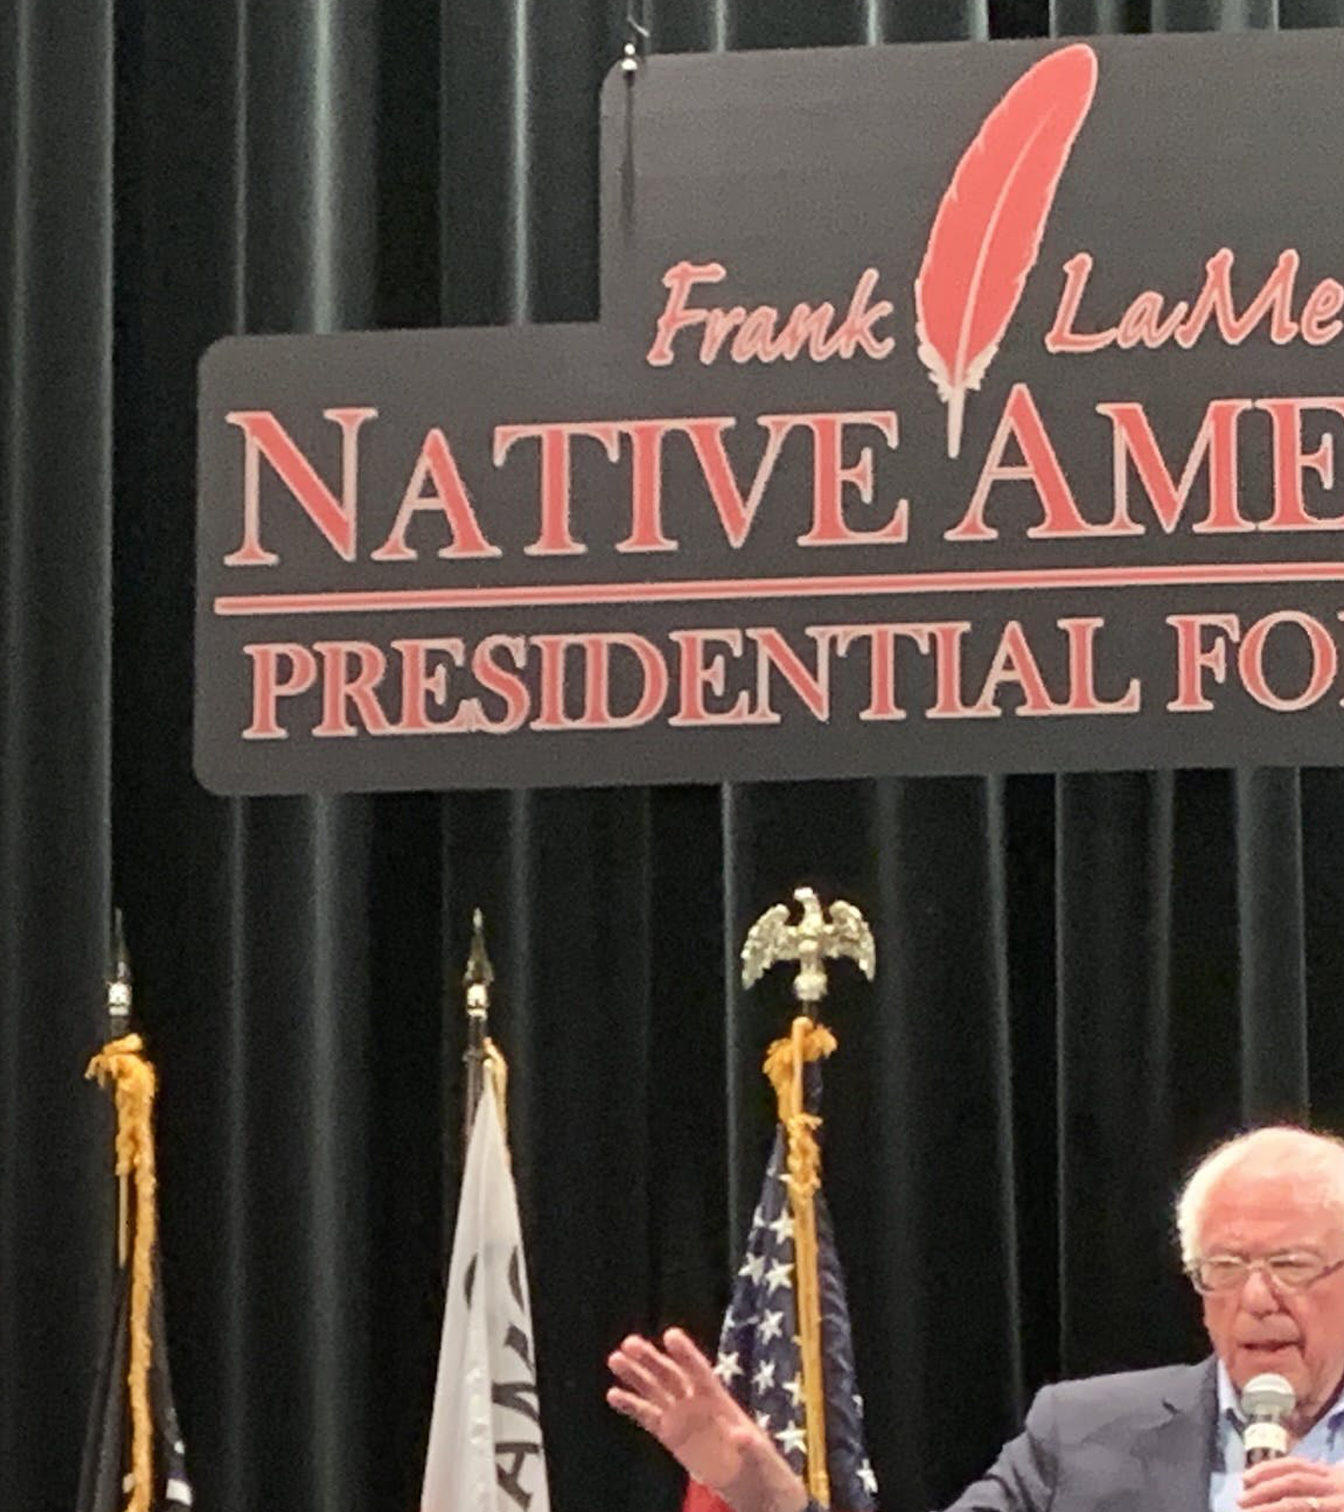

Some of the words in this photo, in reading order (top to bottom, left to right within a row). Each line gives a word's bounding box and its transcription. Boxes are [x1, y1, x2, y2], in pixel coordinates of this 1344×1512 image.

[645, 259, 896, 366] Frank
[224, 406, 910, 566] NATIVE
[242, 616, 1142, 740] PRESIDENTIAL
